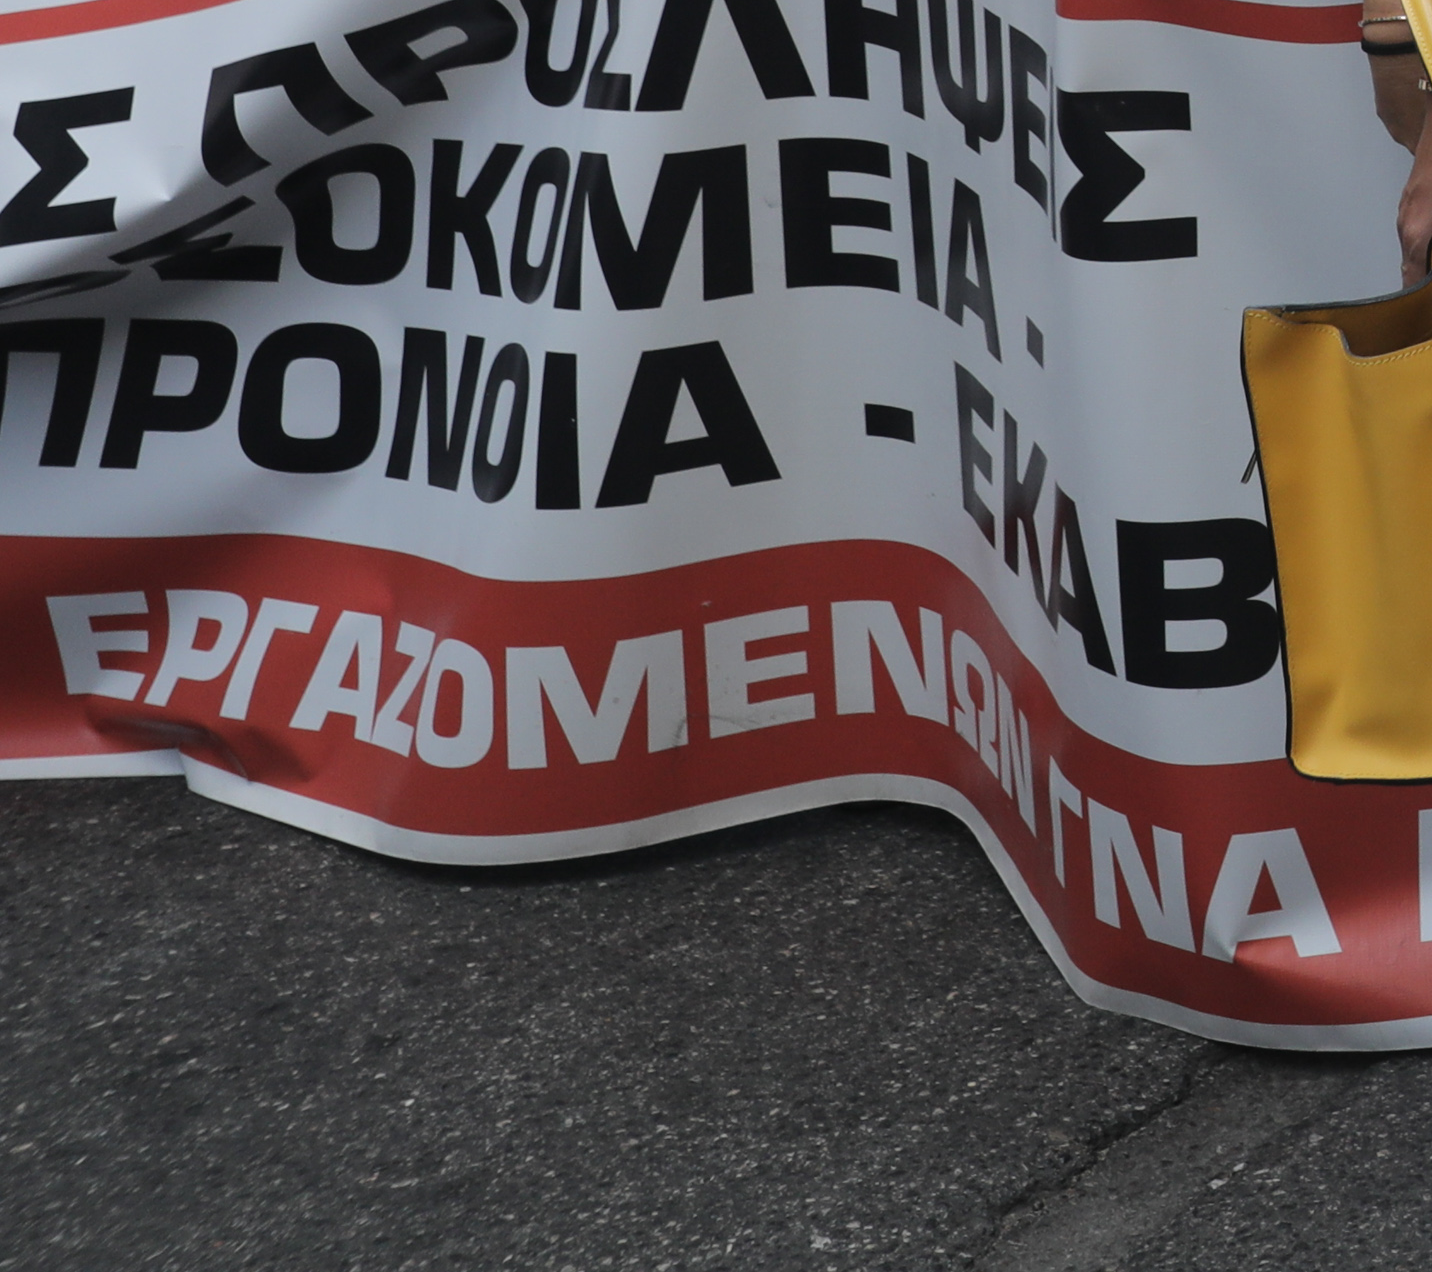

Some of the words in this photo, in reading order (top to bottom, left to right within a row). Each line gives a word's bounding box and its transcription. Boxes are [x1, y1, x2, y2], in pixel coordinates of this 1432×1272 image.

[0, 317, 783, 511] ΠΡΟΝΟΙΑ
[954, 360, 1280, 690] ΕΚΑΒ
[46, 587, 1037, 838] ΕΡΓΑΖΟΜΕΝΩΝ
[1049, 755, 1342, 964] ΓΝΑ
